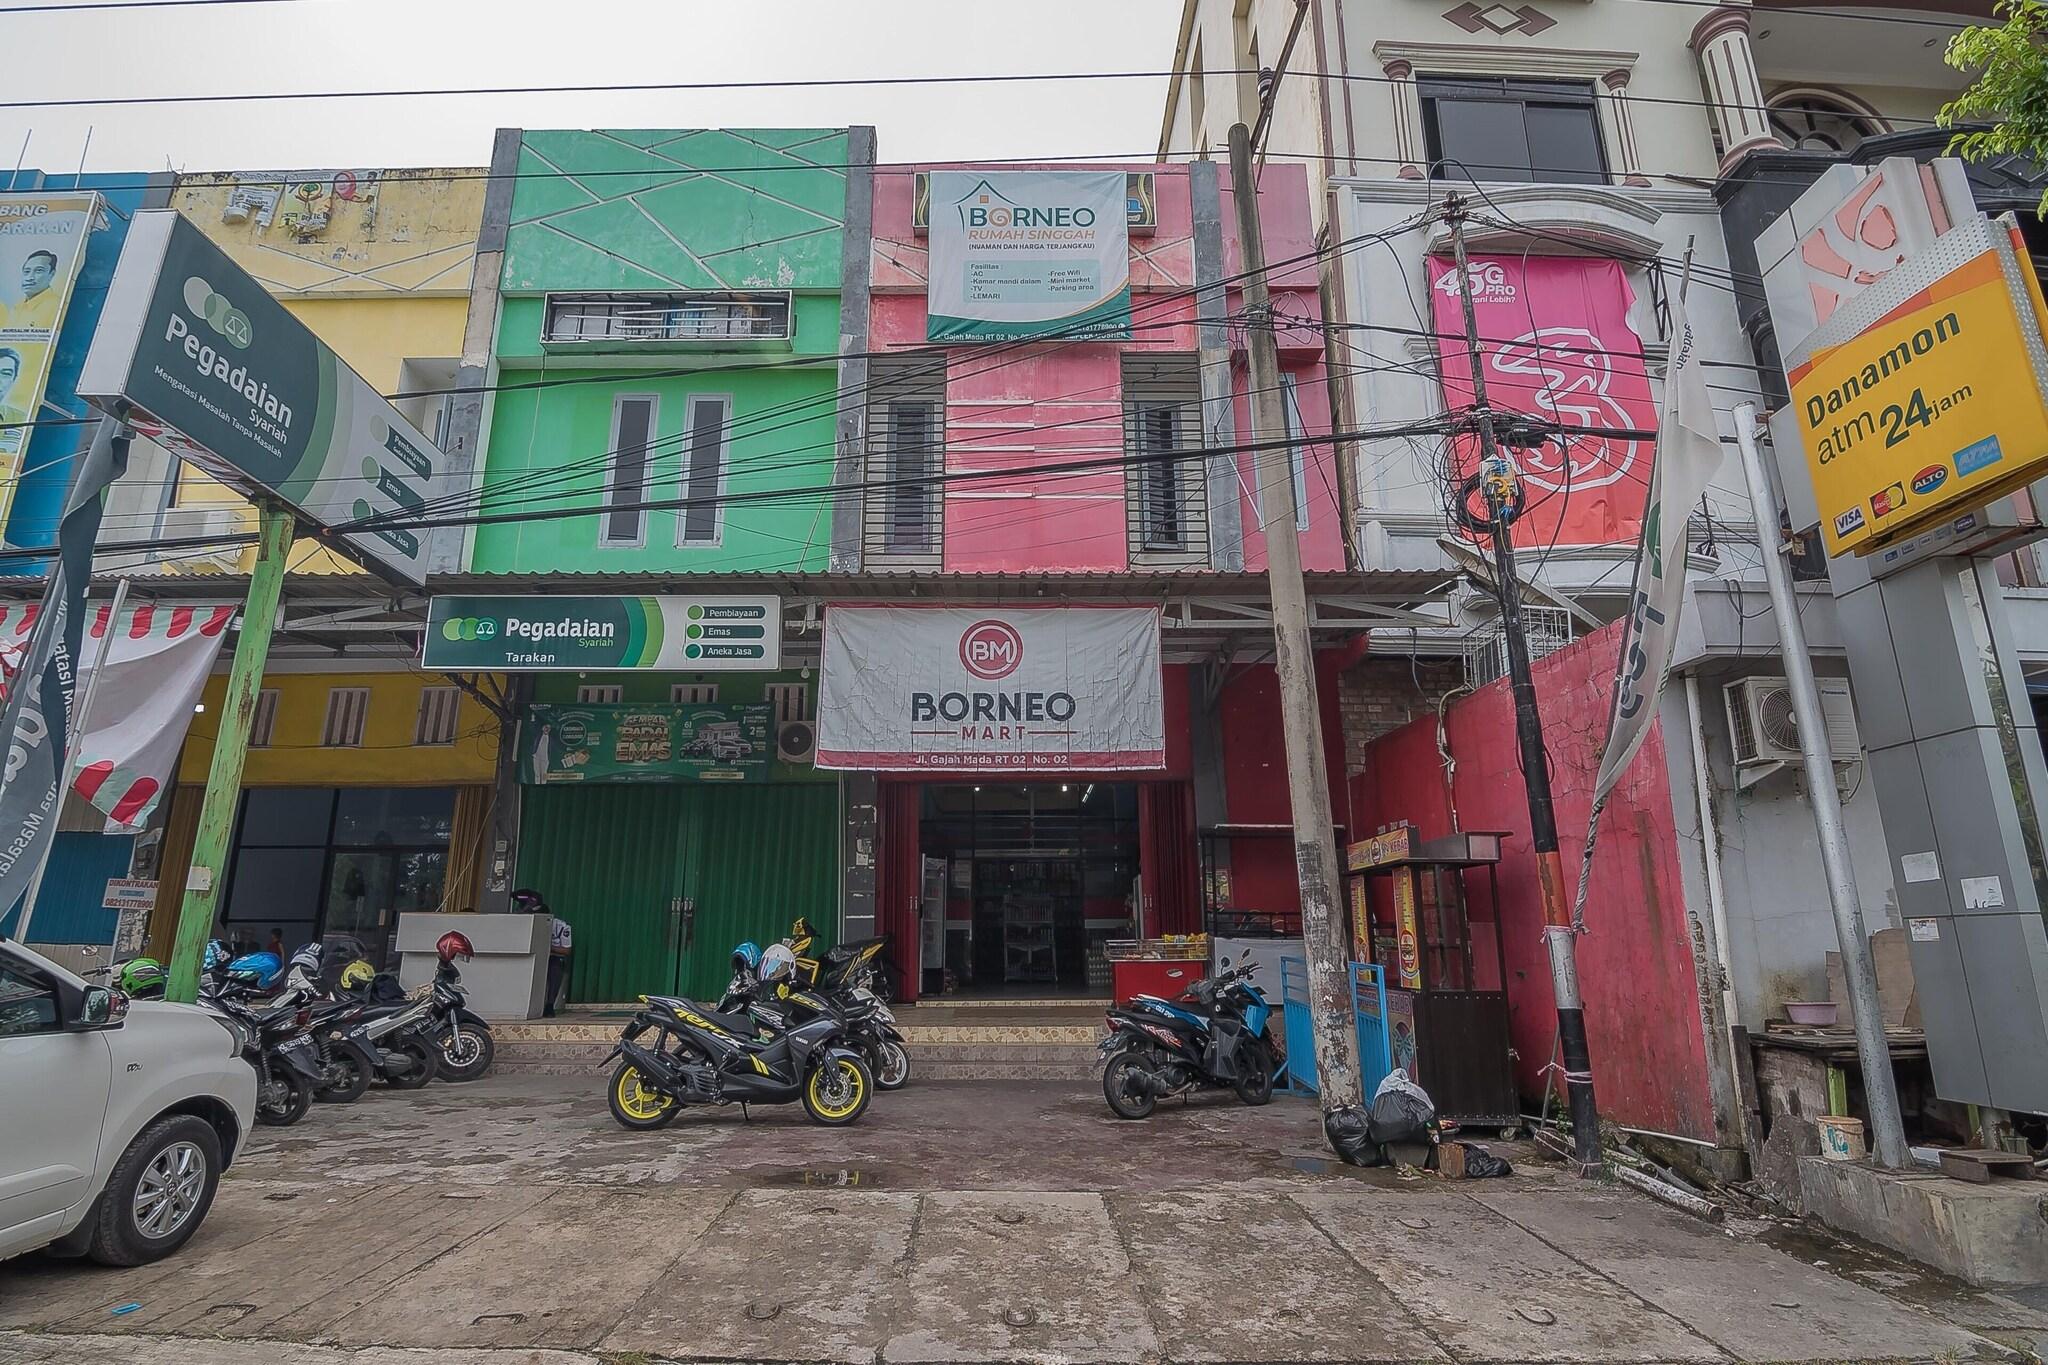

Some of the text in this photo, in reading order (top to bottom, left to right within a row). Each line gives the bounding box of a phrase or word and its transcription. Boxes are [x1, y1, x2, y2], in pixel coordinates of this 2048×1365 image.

[970, 207, 1096, 227] BORNEO
[968, 230, 1096, 240] RUMAH SINGGAH
[1046, 242, 1095, 250] TERJANGKAU)
[1485, 285, 1516, 295] PRO
[165, 313, 292, 428] Pegadaian
[1806, 312, 1961, 429] Danamon
[154, 365, 282, 458] Mengatasi Masalah Tanpa Masalah
[249, 408, 287, 445] Syariah
[1818, 385, 1972, 465] atm 24 jam
[385, 479, 401, 497] Emas
[1914, 470, 1944, 490] ALTO
[1838, 508, 1862, 529] VISA
[709, 608, 759, 619] Pembiayaan
[506, 618, 614, 641] Pegadaian
[708, 627, 731, 636] Emas
[578, 637, 614, 648] Syariah
[707, 646, 752, 656] Aneka Jasa
[506, 652, 555, 663] Tarakan
[912, 693, 1076, 722] BORNEO
[962, 727, 1026, 740] MART
[616, 742, 672, 761] EMAS
[915, 755, 1068, 768] Jl. Gajah Mada RT 02 No. 02
